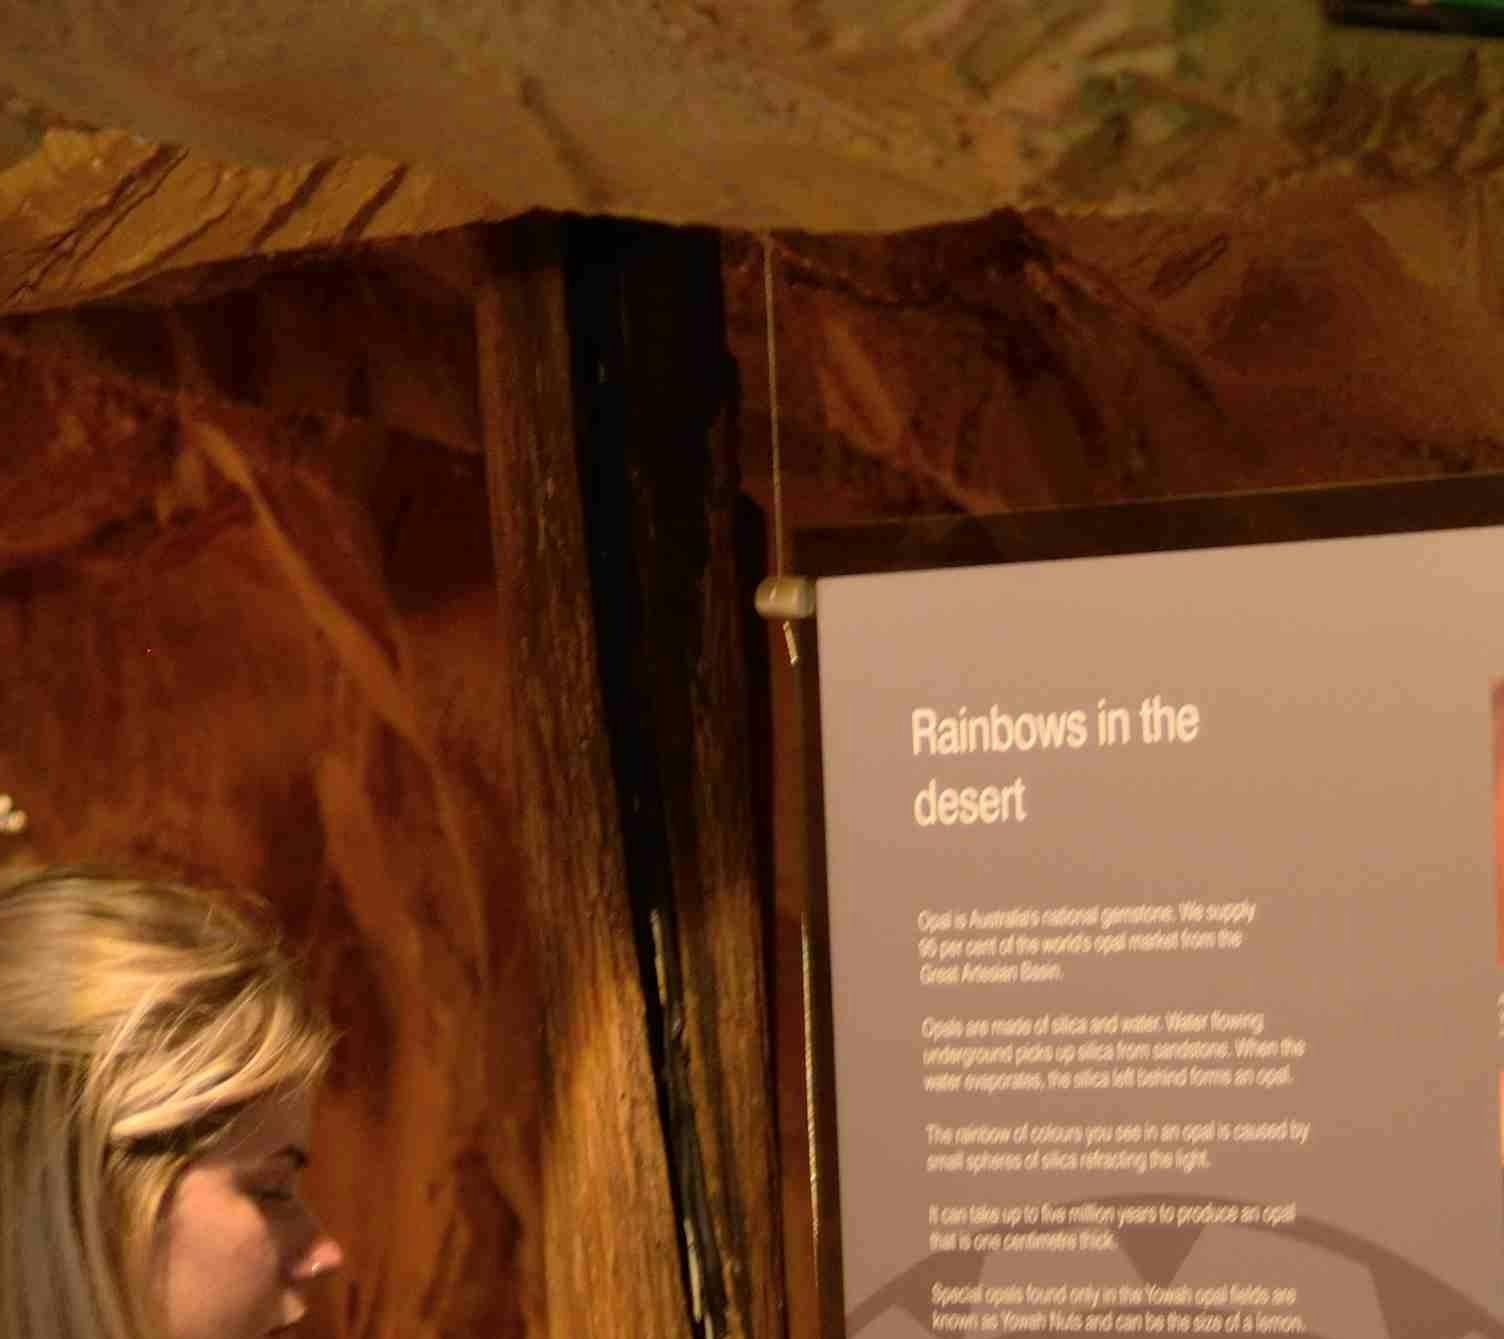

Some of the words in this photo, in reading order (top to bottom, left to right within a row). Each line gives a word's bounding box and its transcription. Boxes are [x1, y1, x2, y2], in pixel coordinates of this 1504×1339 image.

[911, 704, 1088, 755] Rainbows
[1097, 698, 1132, 745] in
[1140, 695, 1200, 744] the
[913, 777, 1028, 827] desert
